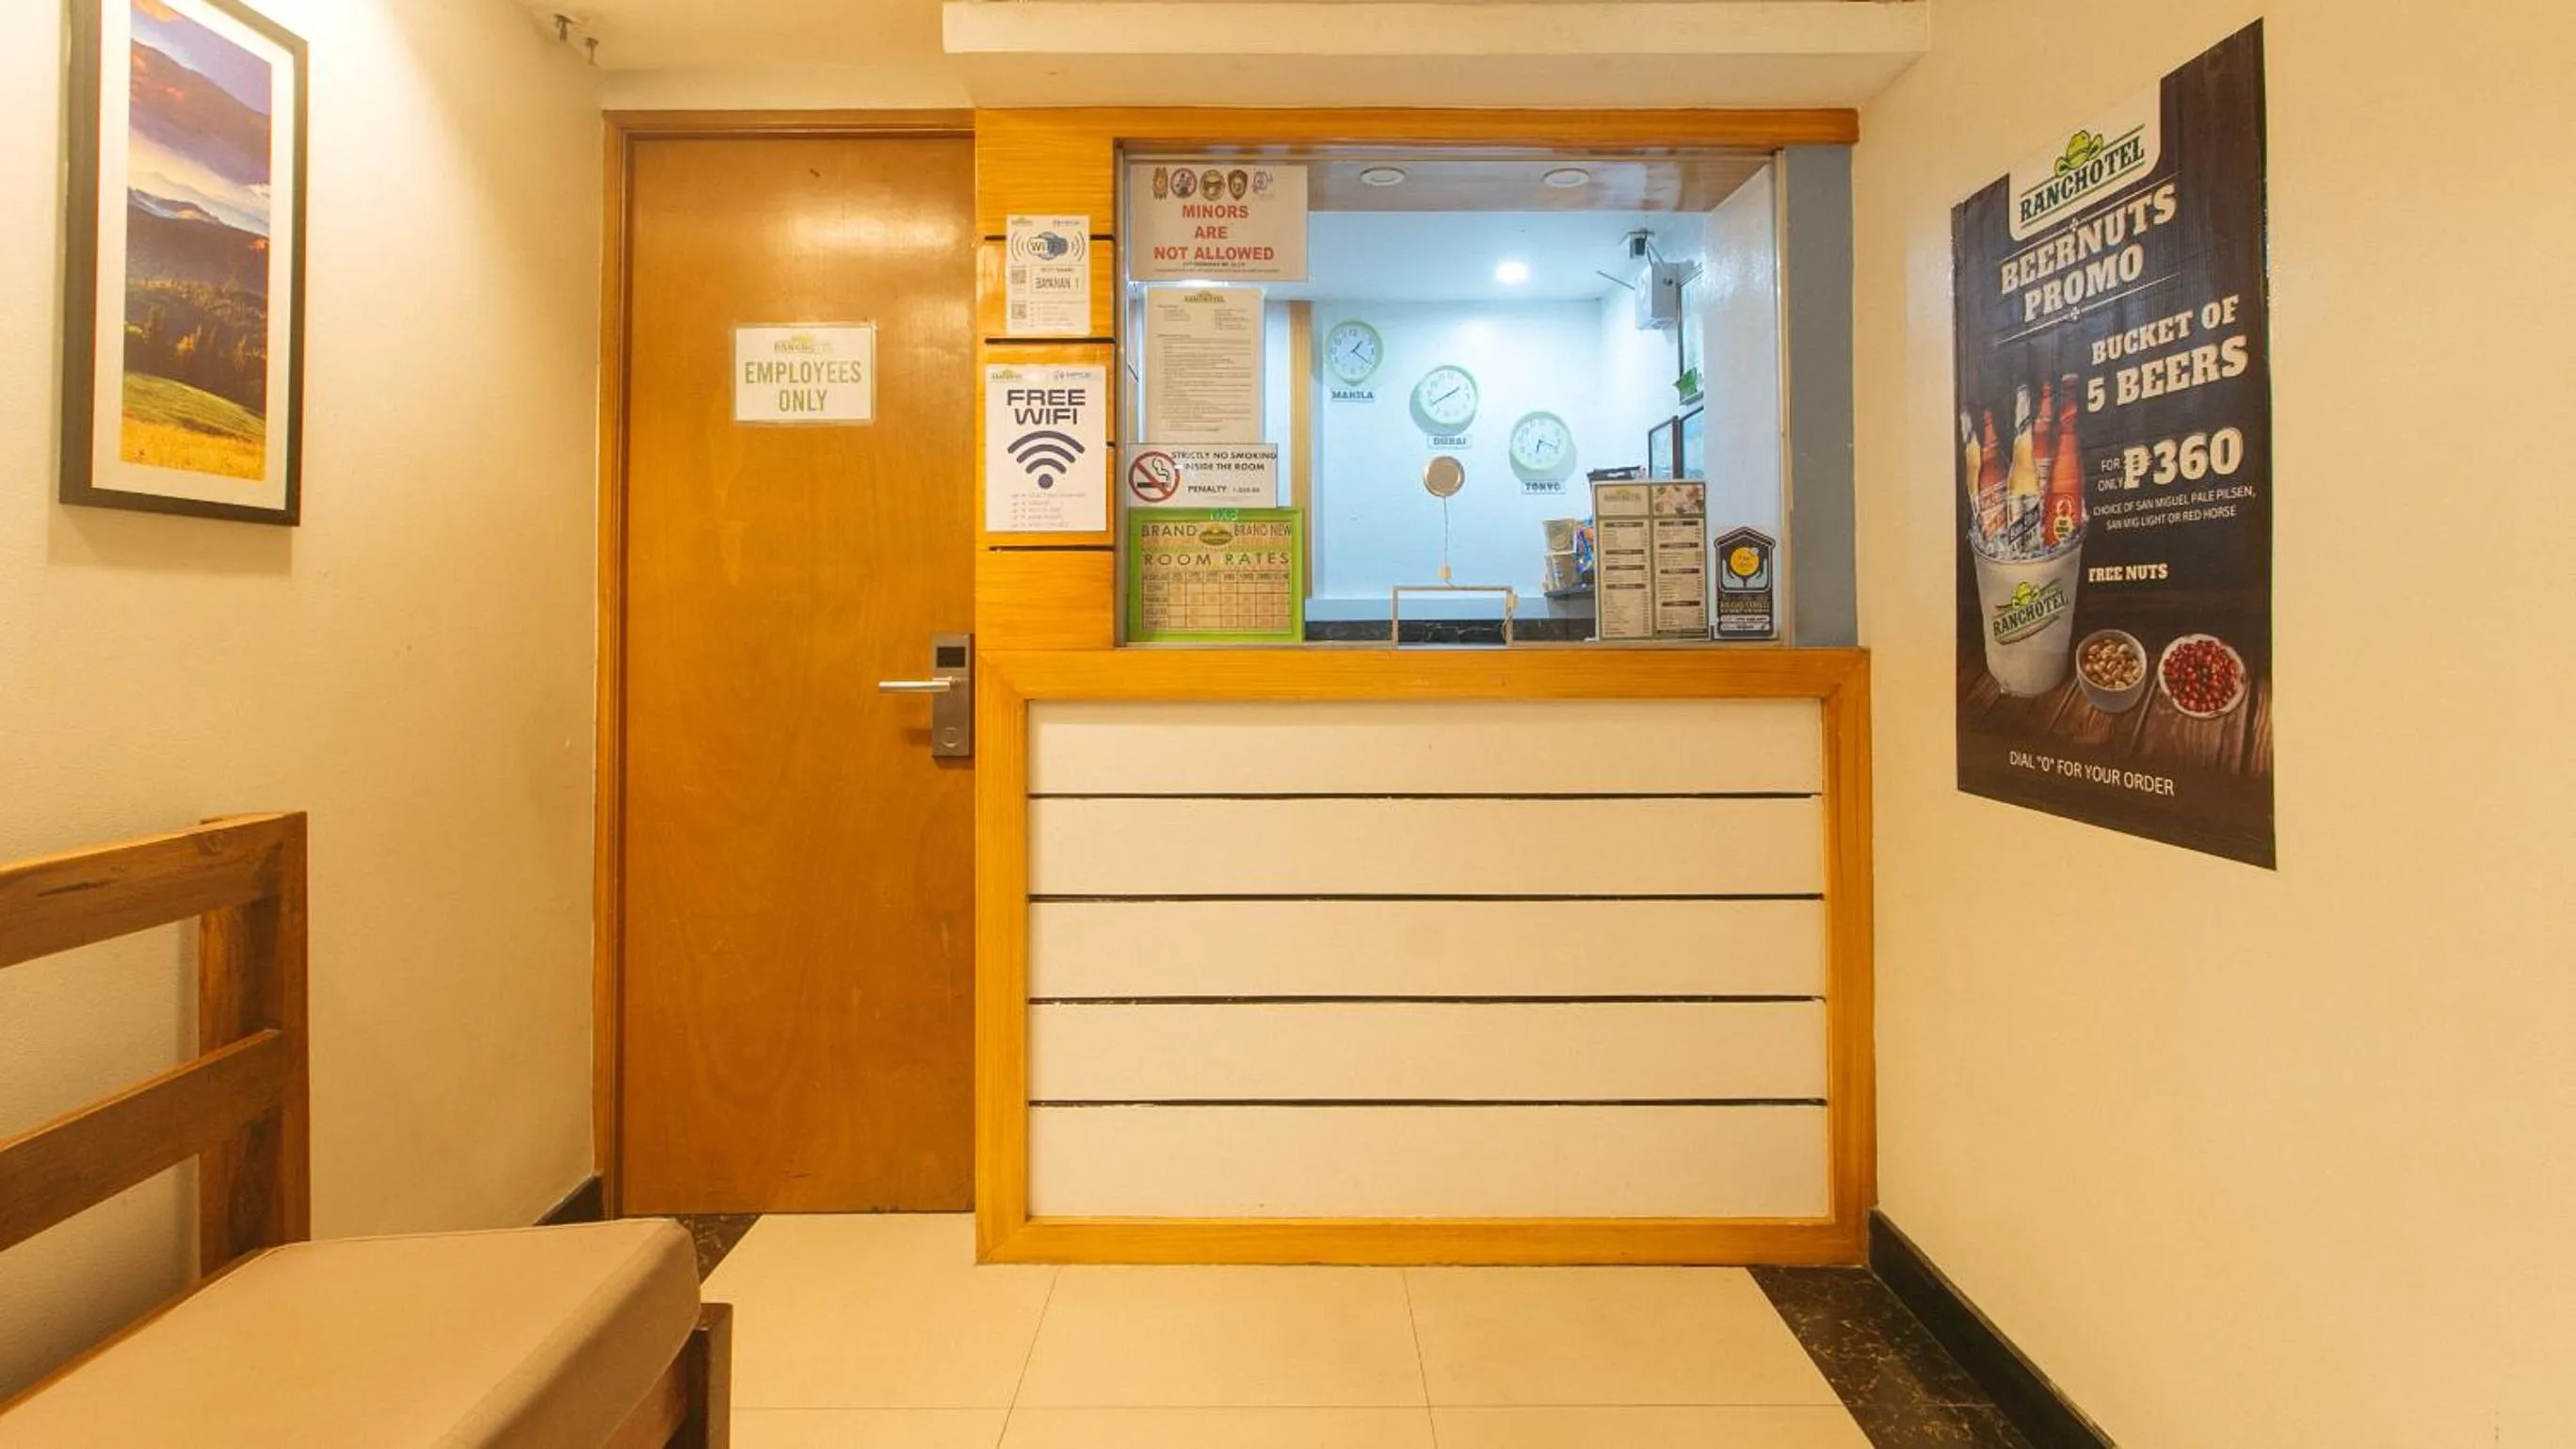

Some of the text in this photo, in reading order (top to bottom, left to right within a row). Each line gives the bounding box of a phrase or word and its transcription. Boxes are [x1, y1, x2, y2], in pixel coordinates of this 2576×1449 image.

[2020, 135, 2146, 223] RANCHOTEL
[1182, 204, 1249, 219] MINORS
[1194, 226, 1229, 239] ARE
[2000, 183, 2177, 296] BEERNUTS
[1153, 247, 1275, 261] NOT ALLOWED
[2024, 243, 2144, 323] PROMO
[2091, 295, 2240, 366] BUCKET OF
[745, 361, 862, 384] EMPLOYEES
[2086, 334, 2249, 412] 5 BEERS
[779, 389, 828, 412] ONLY
[1006, 389, 1086, 406] FREE
[1015, 408, 1078, 425] WIFI
[1433, 437, 1467, 445] DUBAI
[2101, 458, 2120, 472] FOR
[2098, 478, 2124, 492] ONLY
[2093, 502, 2122, 516] CHOICE
[2123, 500, 2135, 513] OF
[2135, 499, 2154, 512] SAN
[2154, 493, 2190, 508] MIGUEL
[2191, 491, 2214, 503] PALE
[2105, 505, 2238, 531] SAN MIG LIGHT OR RED HORSE
[1142, 524, 1198, 537] BRAND
[1234, 523, 1292, 537] BRAND NEW
[1144, 552, 1290, 566] ROOM RATES
[2088, 563, 2169, 583] FREE NUTS
[1993, 589, 2069, 636] RANCHOTEL
[2009, 750, 2036, 770] DIAL
[2056, 759, 2082, 779] FOR
[2084, 764, 2120, 785] YOUR
[2124, 770, 2175, 797] ORDER
